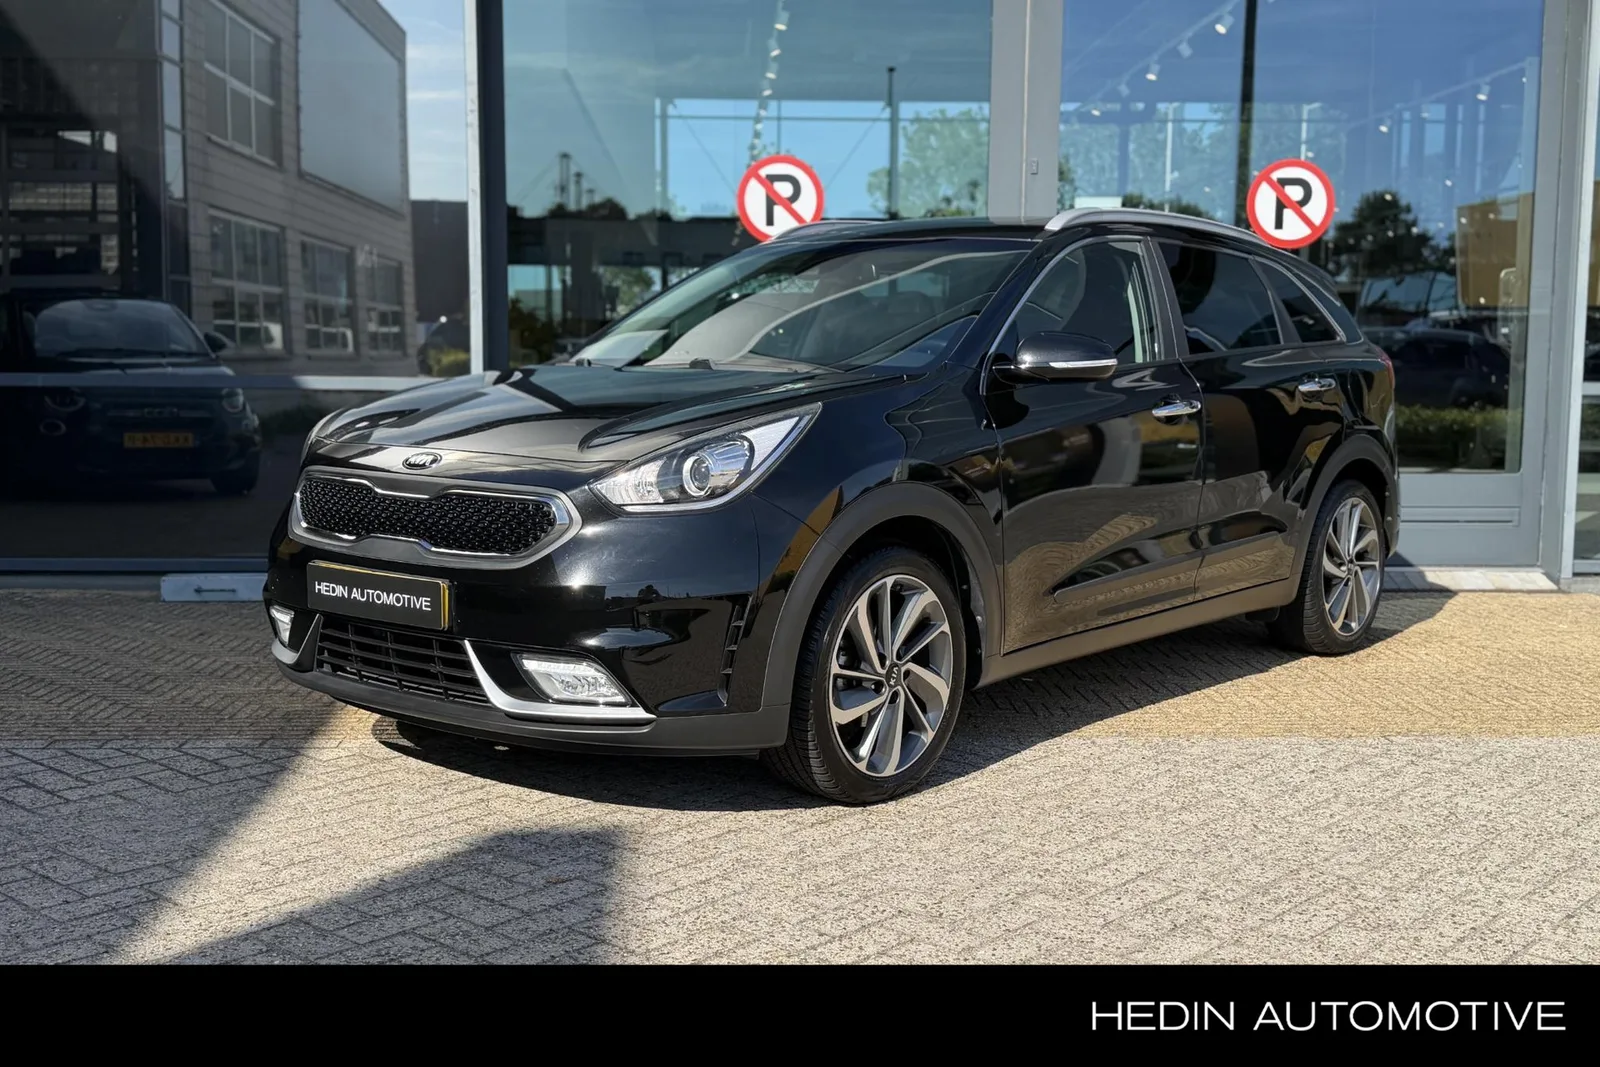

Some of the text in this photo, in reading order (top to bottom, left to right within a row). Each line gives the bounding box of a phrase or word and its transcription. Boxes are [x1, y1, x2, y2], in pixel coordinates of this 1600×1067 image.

[766, 174, 801, 227] P
[1274, 178, 1312, 230] P
[315, 581, 431, 611] HEDIN AUTOMOTIVE
[889, 666, 899, 686] KIA
